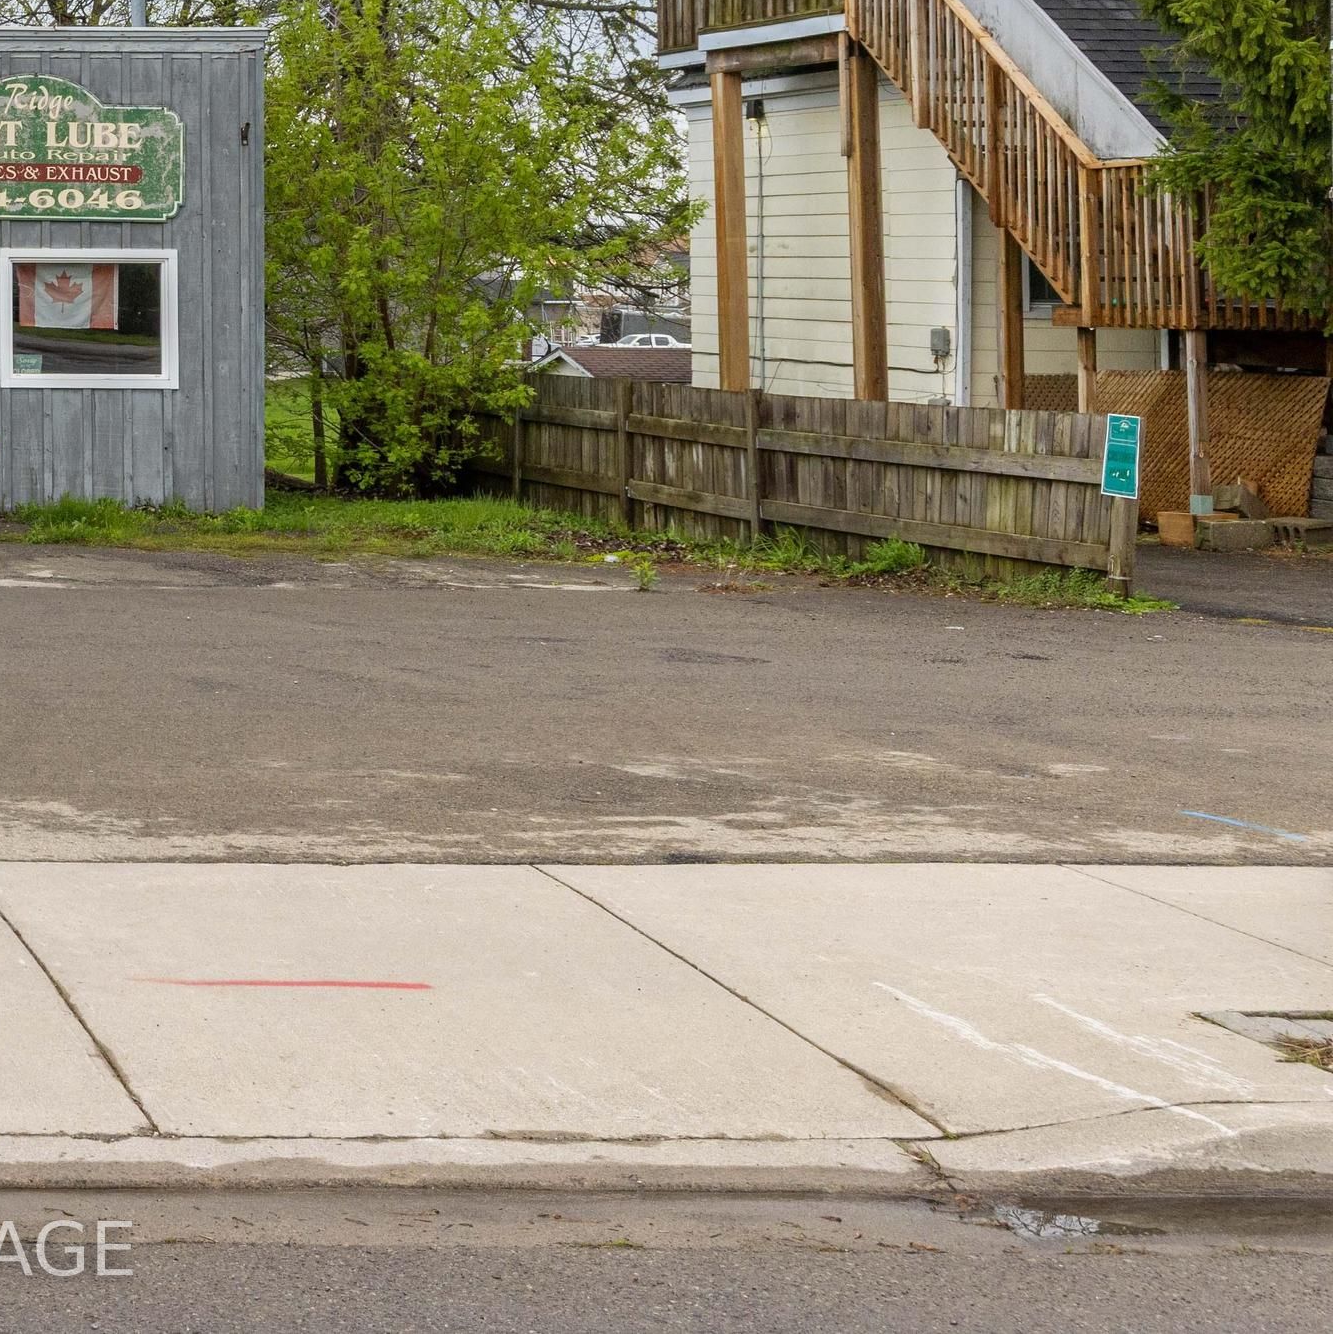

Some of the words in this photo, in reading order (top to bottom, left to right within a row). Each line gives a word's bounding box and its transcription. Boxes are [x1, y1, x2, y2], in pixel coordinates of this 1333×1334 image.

[4, 83, 74, 119] Ridge
[45, 121, 143, 149] LUBE
[47, 149, 132, 164] Repair
[23, 166, 40, 180] &
[46, 166, 132, 182] EXHAUST
